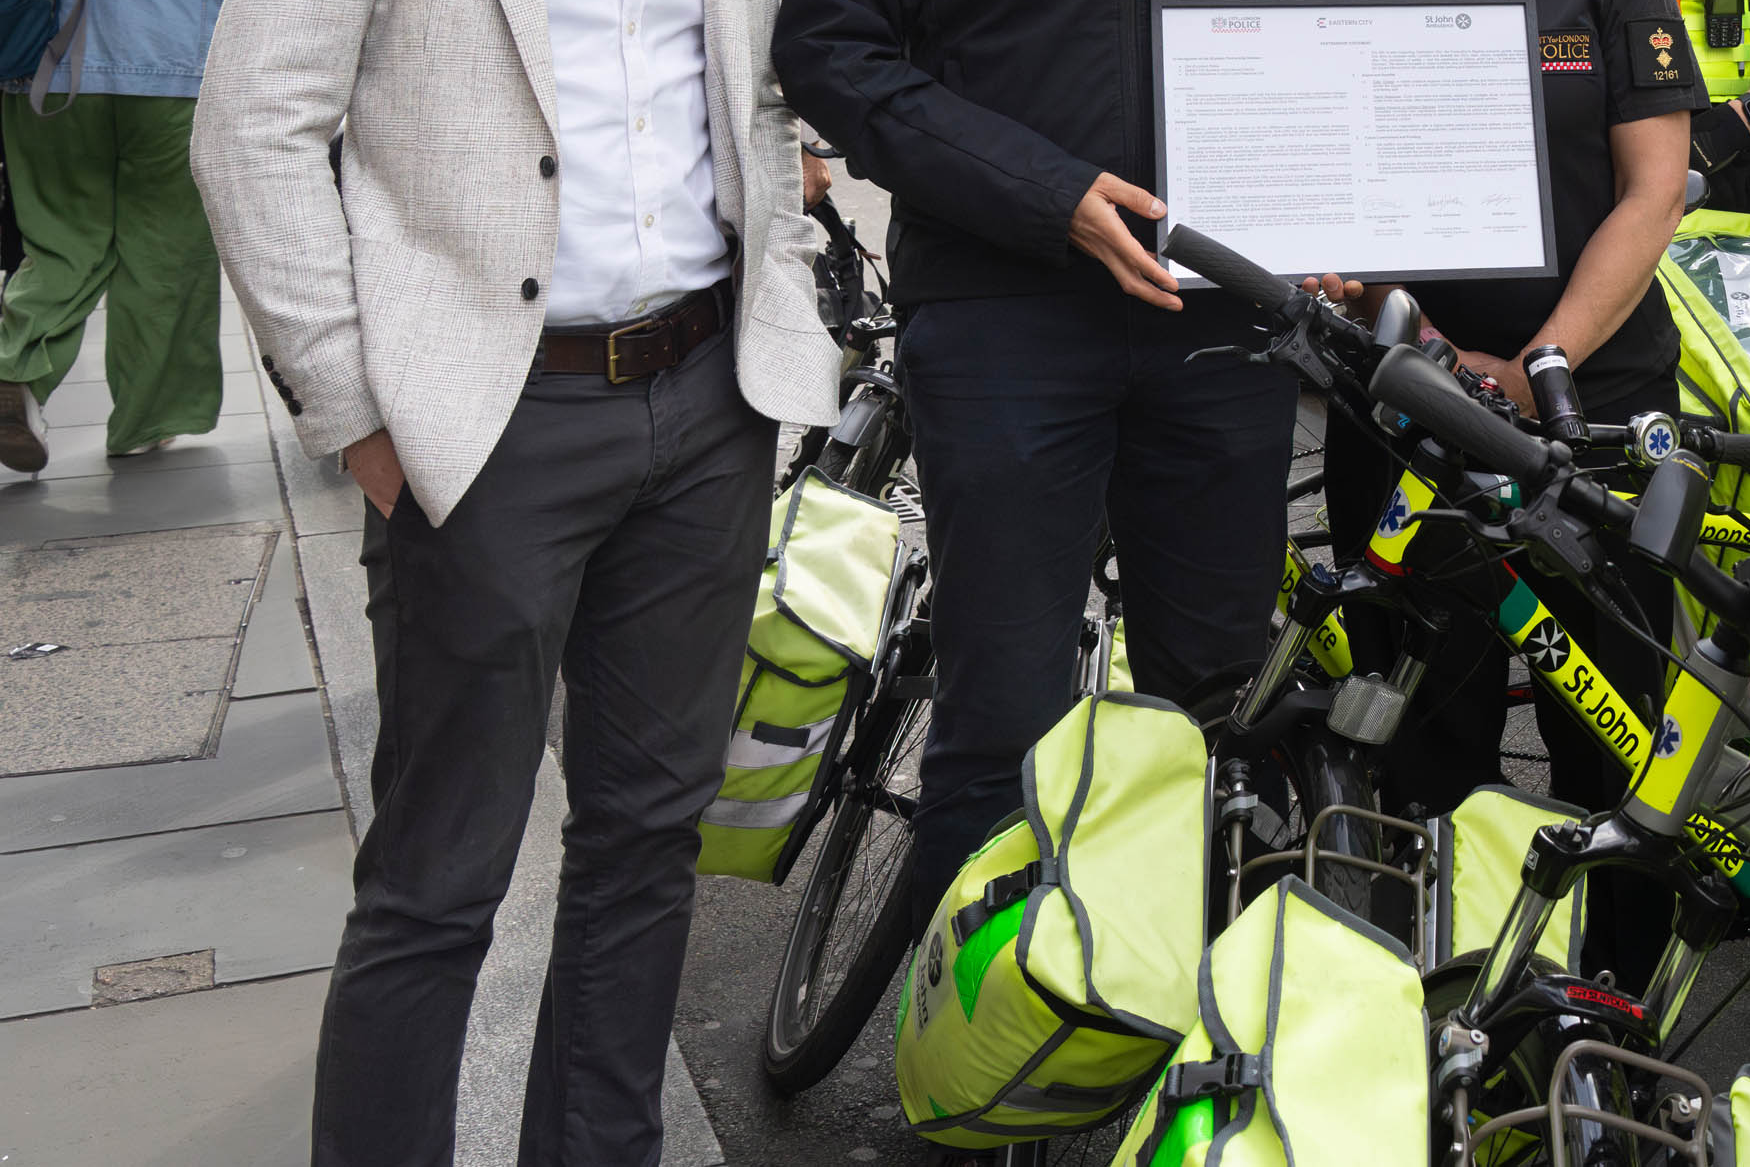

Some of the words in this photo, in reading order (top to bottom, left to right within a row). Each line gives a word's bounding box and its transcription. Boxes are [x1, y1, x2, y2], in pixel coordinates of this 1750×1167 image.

[1228, 20, 1261, 29] POLICE
[1425, 15, 1434, 24] St
[1435, 15, 1454, 25] John
[1539, 35, 1552, 44] ITY
[1558, 34, 1590, 43] LONDON
[1539, 43, 1590, 59] OLICE
[1654, 70, 1679, 81] 12161
[1562, 664, 1595, 705] St
[1584, 691, 1640, 758] John
